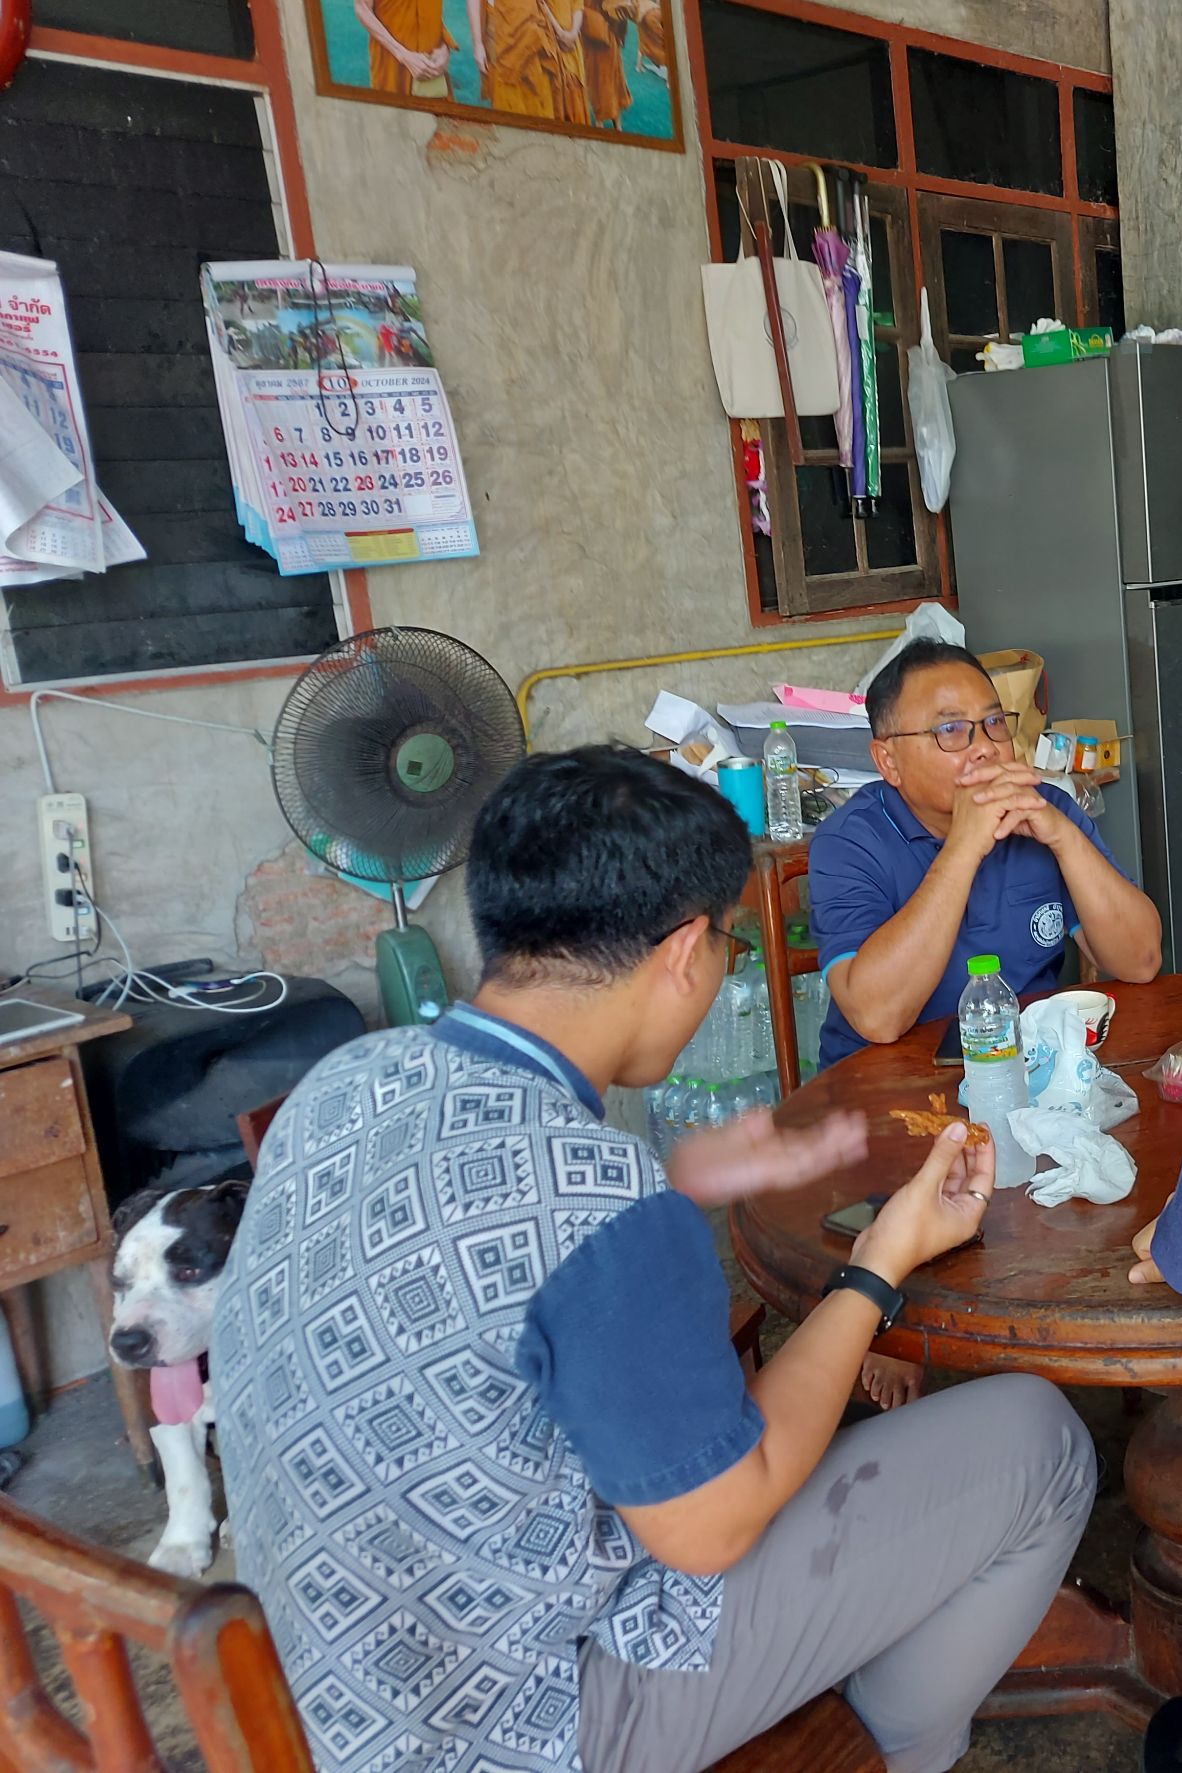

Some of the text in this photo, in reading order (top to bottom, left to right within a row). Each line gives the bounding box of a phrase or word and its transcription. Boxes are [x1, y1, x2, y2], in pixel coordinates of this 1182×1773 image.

[8, 295, 51, 315] จำกัด
[329, 376, 347, 390] 10
[361, 376, 431, 388] OCTOBER 2024
[314, 397, 433, 418] 1 2 3 4 5
[273, 421, 444, 443] 6 7 8 9 10 11 12
[280, 445, 448, 468] 13 14 15 16 17 18 19
[288, 469, 453, 493] 20 21 22 23 24 25 26
[276, 506, 296, 523] 24
[298, 498, 402, 517] 27 28 29 30 31
